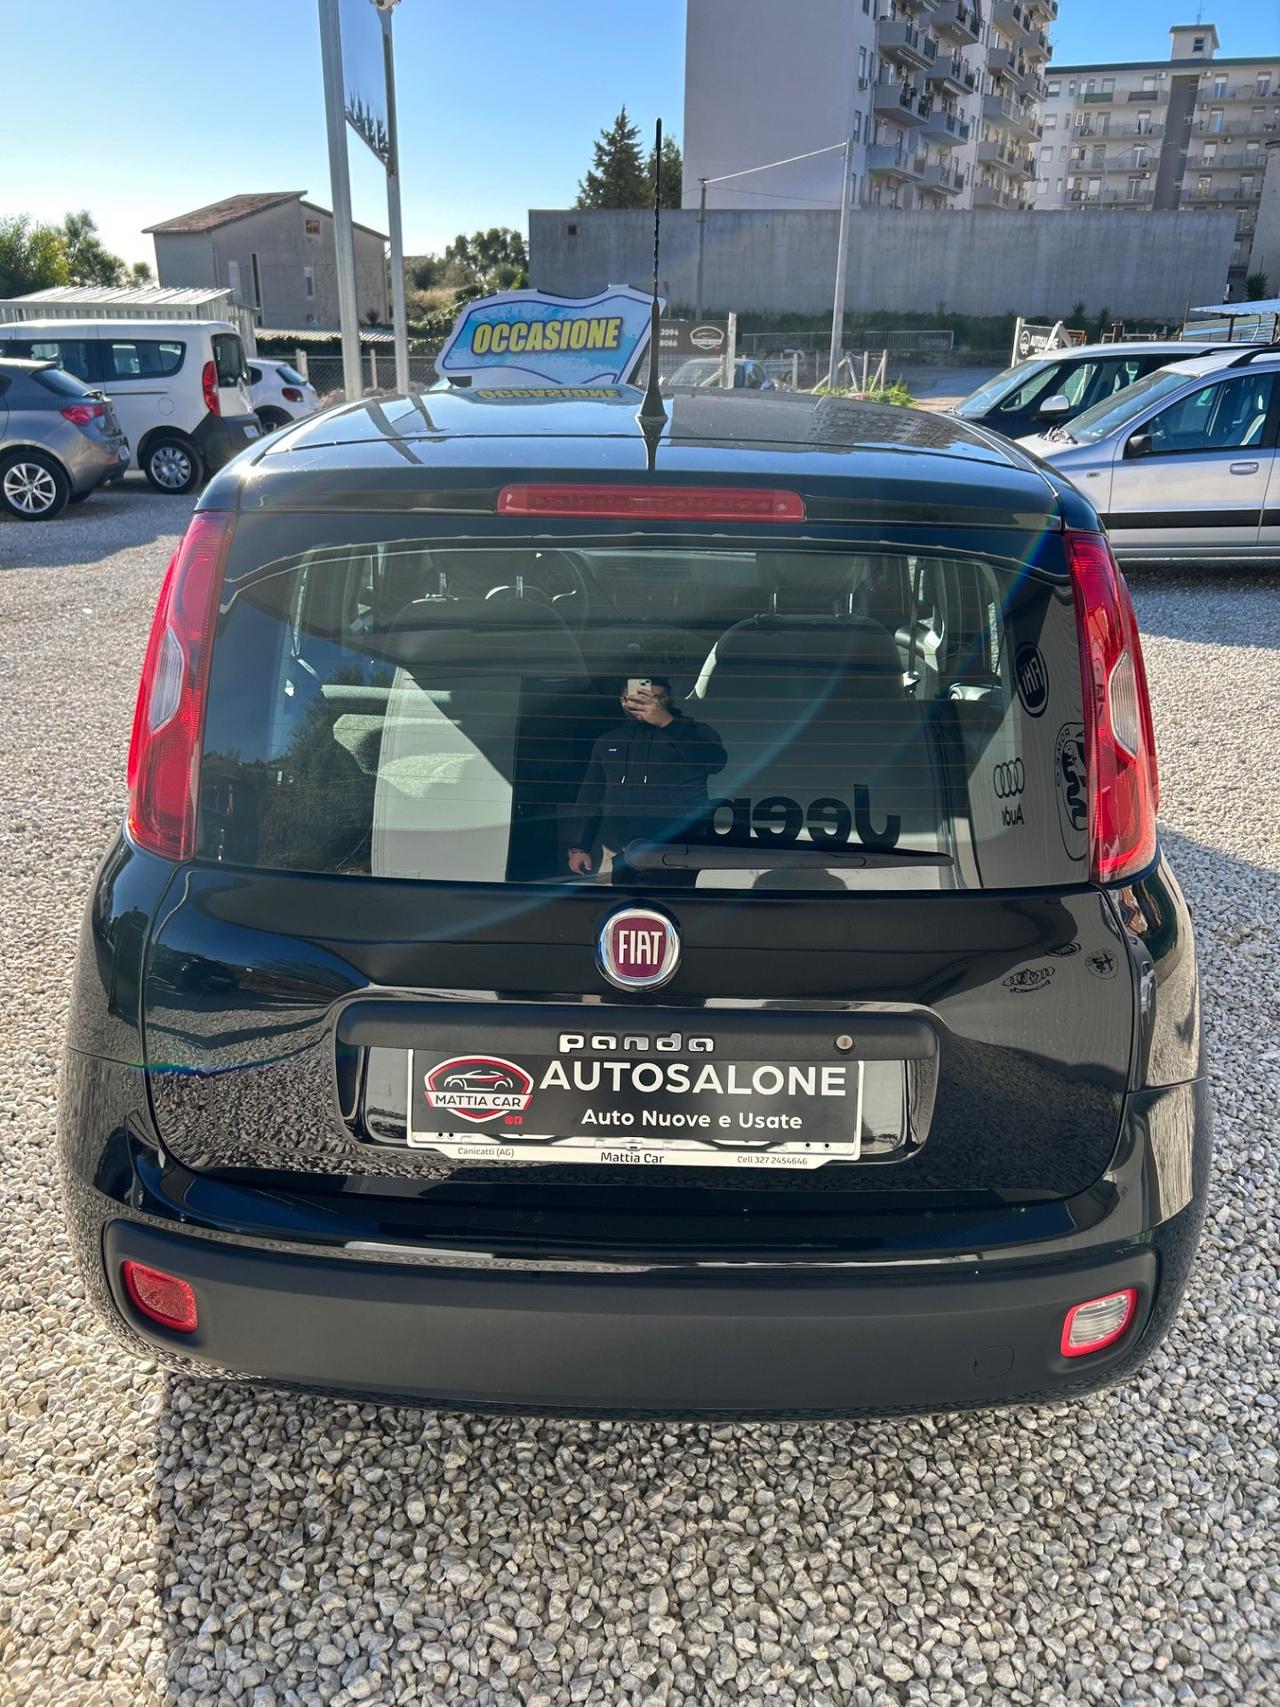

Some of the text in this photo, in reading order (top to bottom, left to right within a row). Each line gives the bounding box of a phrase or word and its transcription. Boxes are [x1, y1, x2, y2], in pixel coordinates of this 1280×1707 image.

[472, 318, 622, 353] OCCASIONE
[618, 930, 663, 965] FIAT
[558, 1032, 715, 1053] panda
[539, 1060, 847, 1096] AUTOSALONE
[435, 1094, 521, 1107] MATTIA CAR
[581, 1108, 803, 1129] Auto Nuove e Usate
[496, 1147, 515, 1158] (AG)
[600, 1152, 665, 1164] Mattia Car
[737, 1155, 753, 1164] Cell
[754, 1156, 770, 1165] 327
